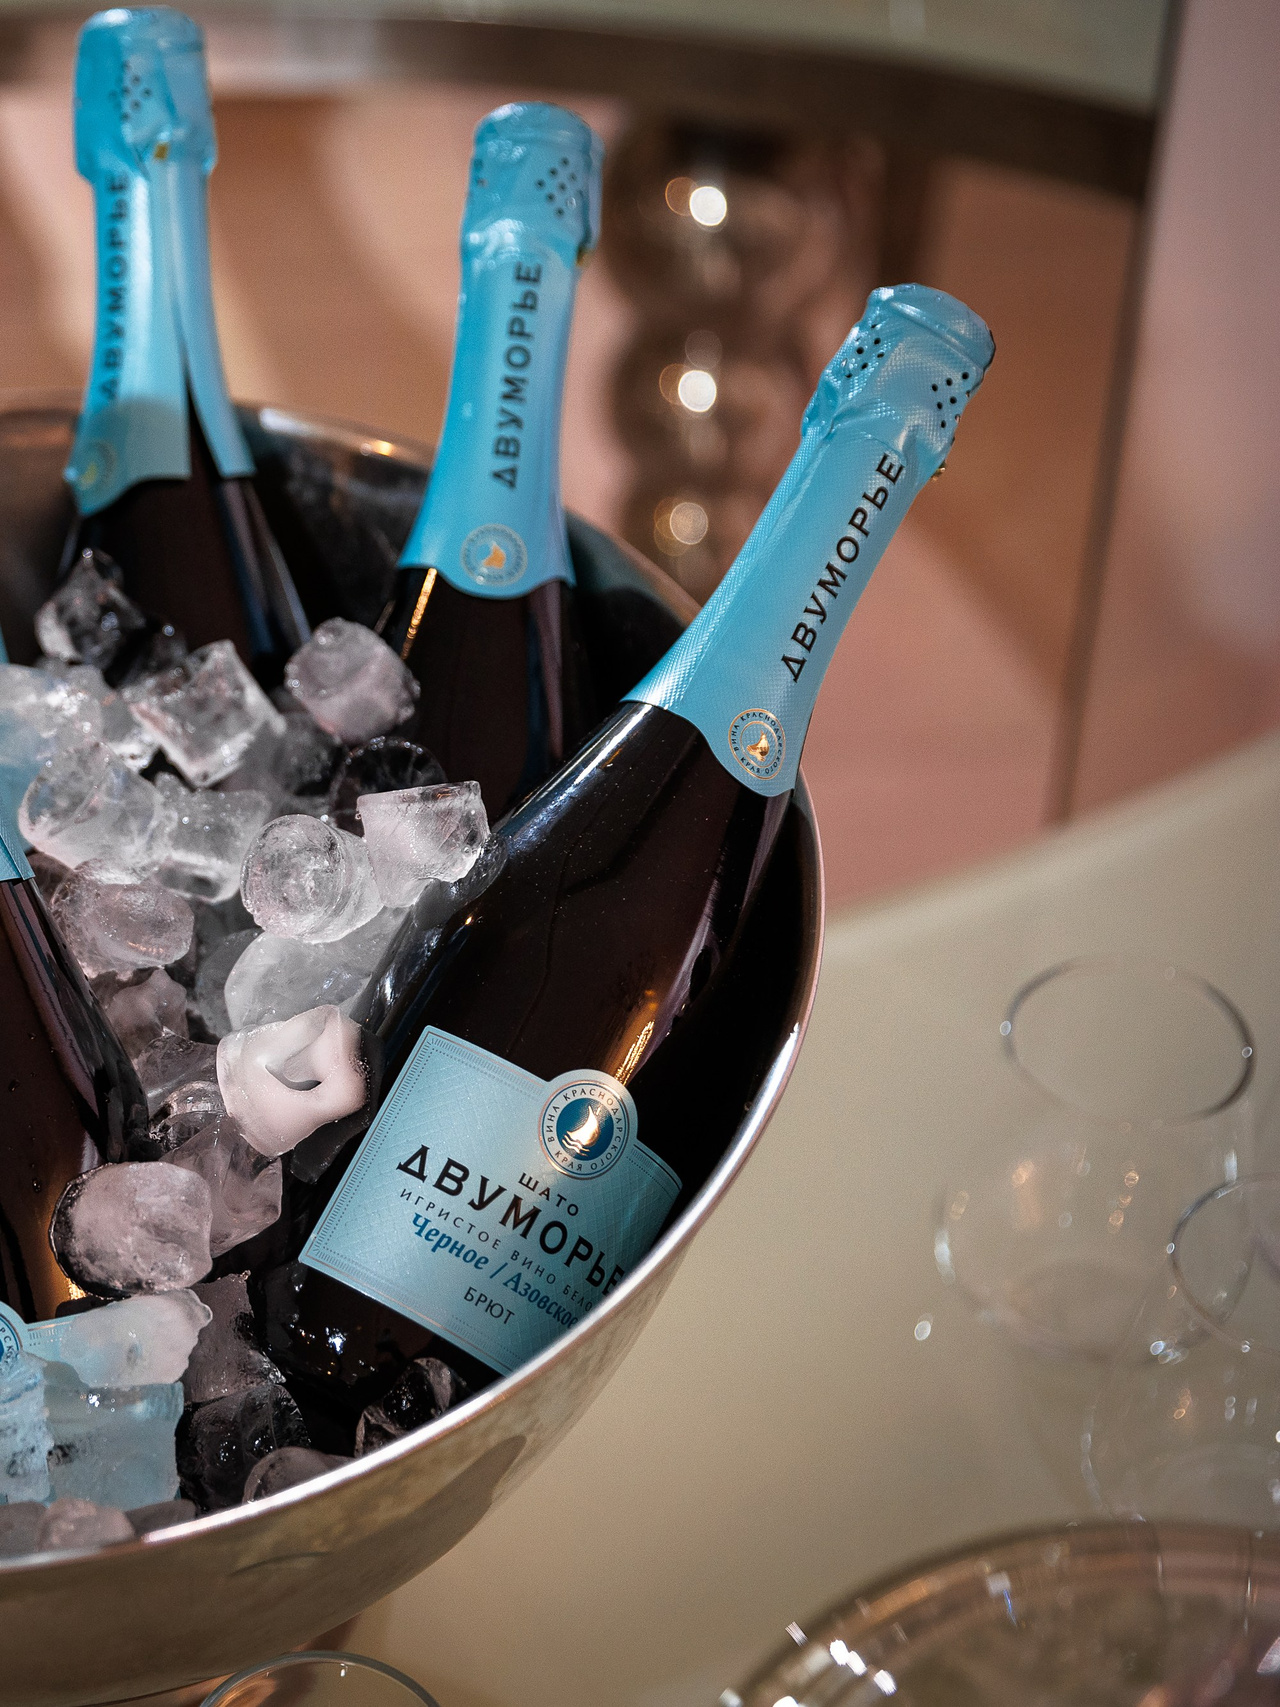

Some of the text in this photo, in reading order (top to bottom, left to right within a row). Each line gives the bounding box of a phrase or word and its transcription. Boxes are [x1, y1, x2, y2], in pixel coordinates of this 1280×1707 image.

[488, 261, 543, 489] ДВУМОРЬЕ
[781, 453, 904, 683] ДВУМОРЬЕ
[546, 1088, 623, 1171] ВИНА КРАСНОДАРСКОГО КРАЯ
[518, 1172, 579, 1216] ШАТО
[400, 1187, 593, 1312] ИГРИСТОЕ ВИНО БЕЛО
[411, 1212, 489, 1270] Черное
[463, 1286, 516, 1326] БРЮТ
